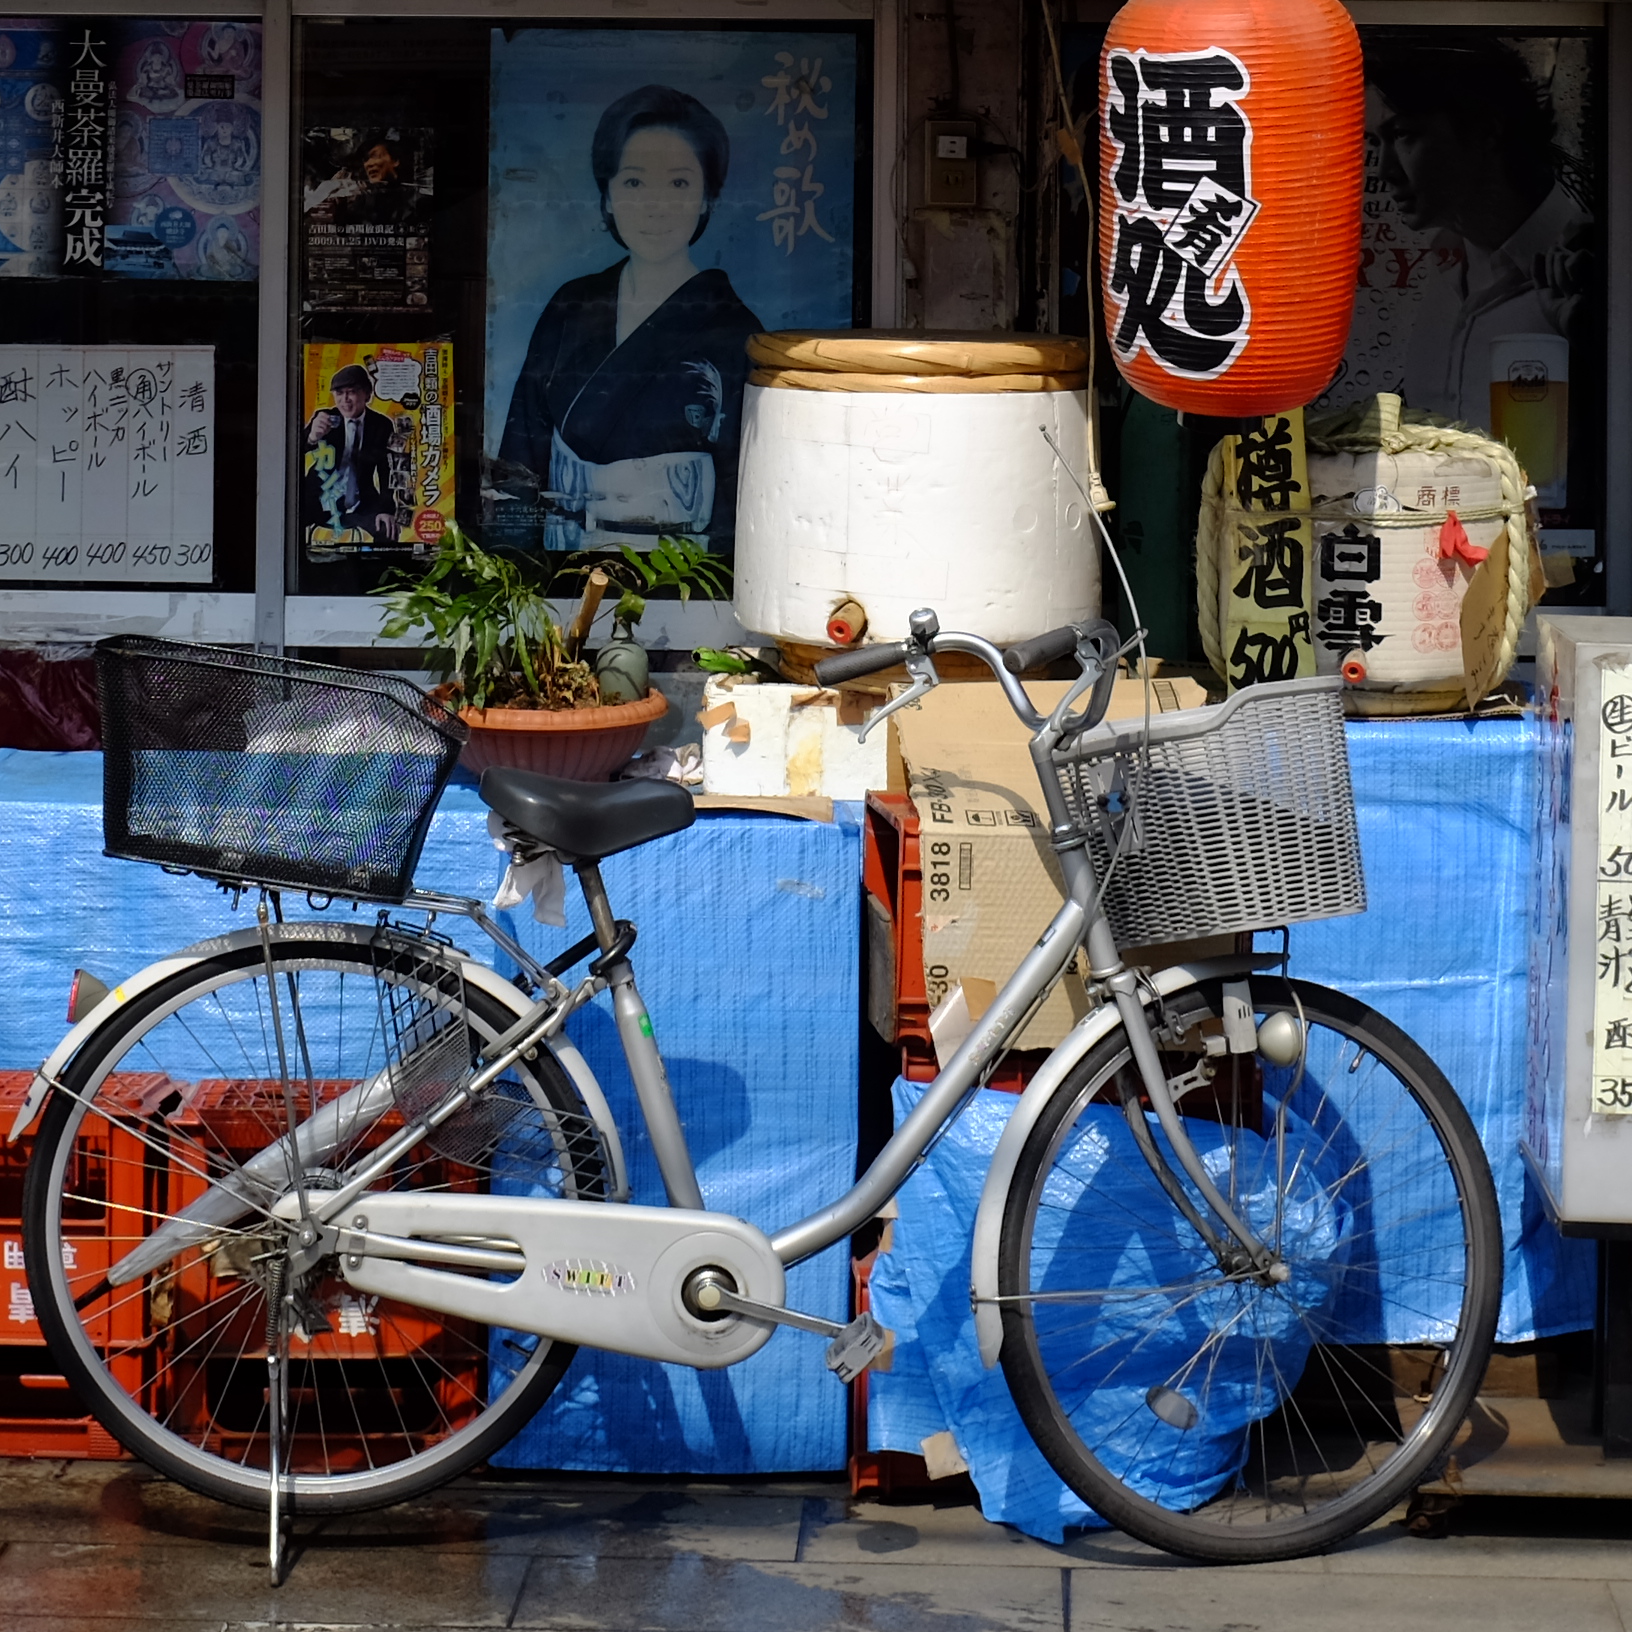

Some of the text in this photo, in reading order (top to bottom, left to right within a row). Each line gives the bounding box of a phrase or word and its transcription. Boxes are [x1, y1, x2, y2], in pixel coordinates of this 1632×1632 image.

[754, 50, 834, 256] 秘め歌
[45, 363, 79, 503] ホッピー
[83, 368, 110, 471] ハイボール
[176, 380, 209, 458] 清酒
[1232, 416, 1304, 610] 樽酒
[1416, 485, 1461, 509] 商標
[42, 544, 79, 570] 400
[86, 541, 127, 566] 400
[132, 542, 171, 568] 450
[174, 543, 212, 568] 300
[929, 841, 951, 903] 3818
[550, 1267, 629, 1289] SWIFT
